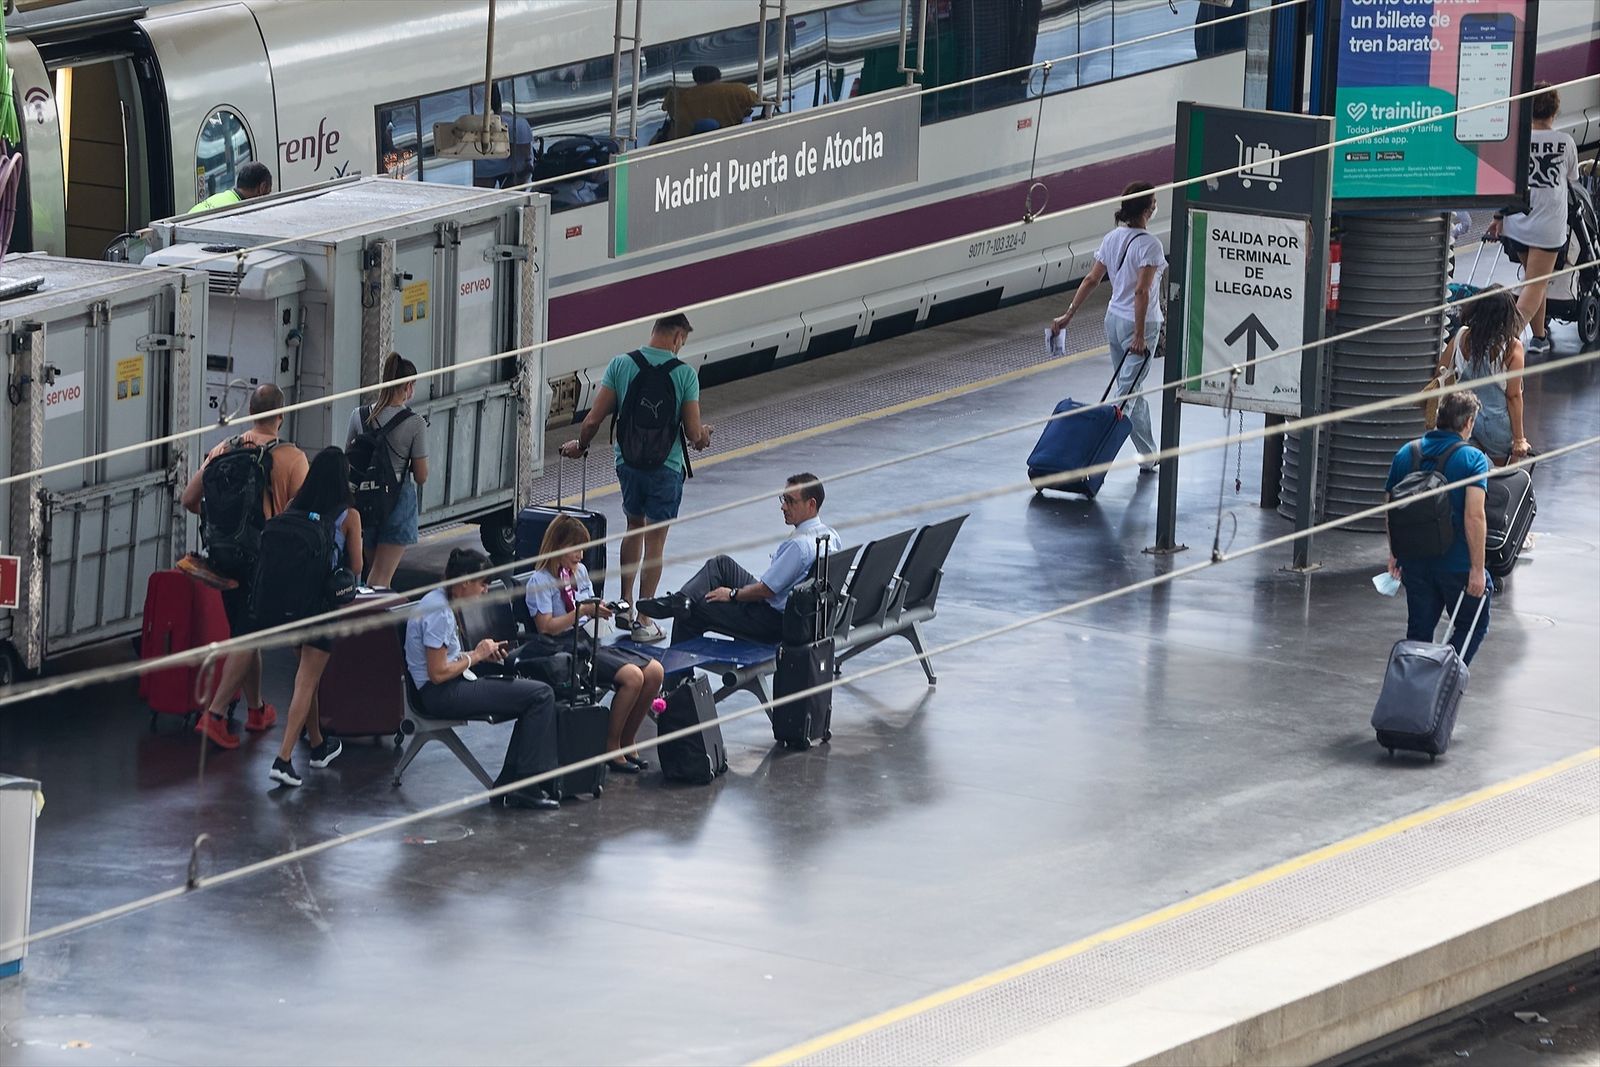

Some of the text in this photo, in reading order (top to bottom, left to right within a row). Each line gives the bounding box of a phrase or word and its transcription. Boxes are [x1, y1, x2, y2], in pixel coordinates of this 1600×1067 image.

[1350, 9, 1451, 29] un billete de
[1349, 34, 1444, 52] tren barato.
[1371, 101, 1442, 120] trainline
[1346, 125, 1369, 134] Todos
[1411, 126, 1416, 134] y
[1418, 123, 1442, 133] tarifas
[278, 117, 340, 171] renfe
[1373, 135, 1390, 145] sola
[655, 127, 883, 212] Madrid Puerta de Atocha
[1211, 228, 1299, 249] SALIDA POR
[1218, 247, 1291, 266] TERMINAL
[1244, 267, 1264, 280] DE
[460, 277, 491, 296] serveo
[1215, 280, 1293, 300] LLEGADAS
[46, 385, 81, 406] serveo
